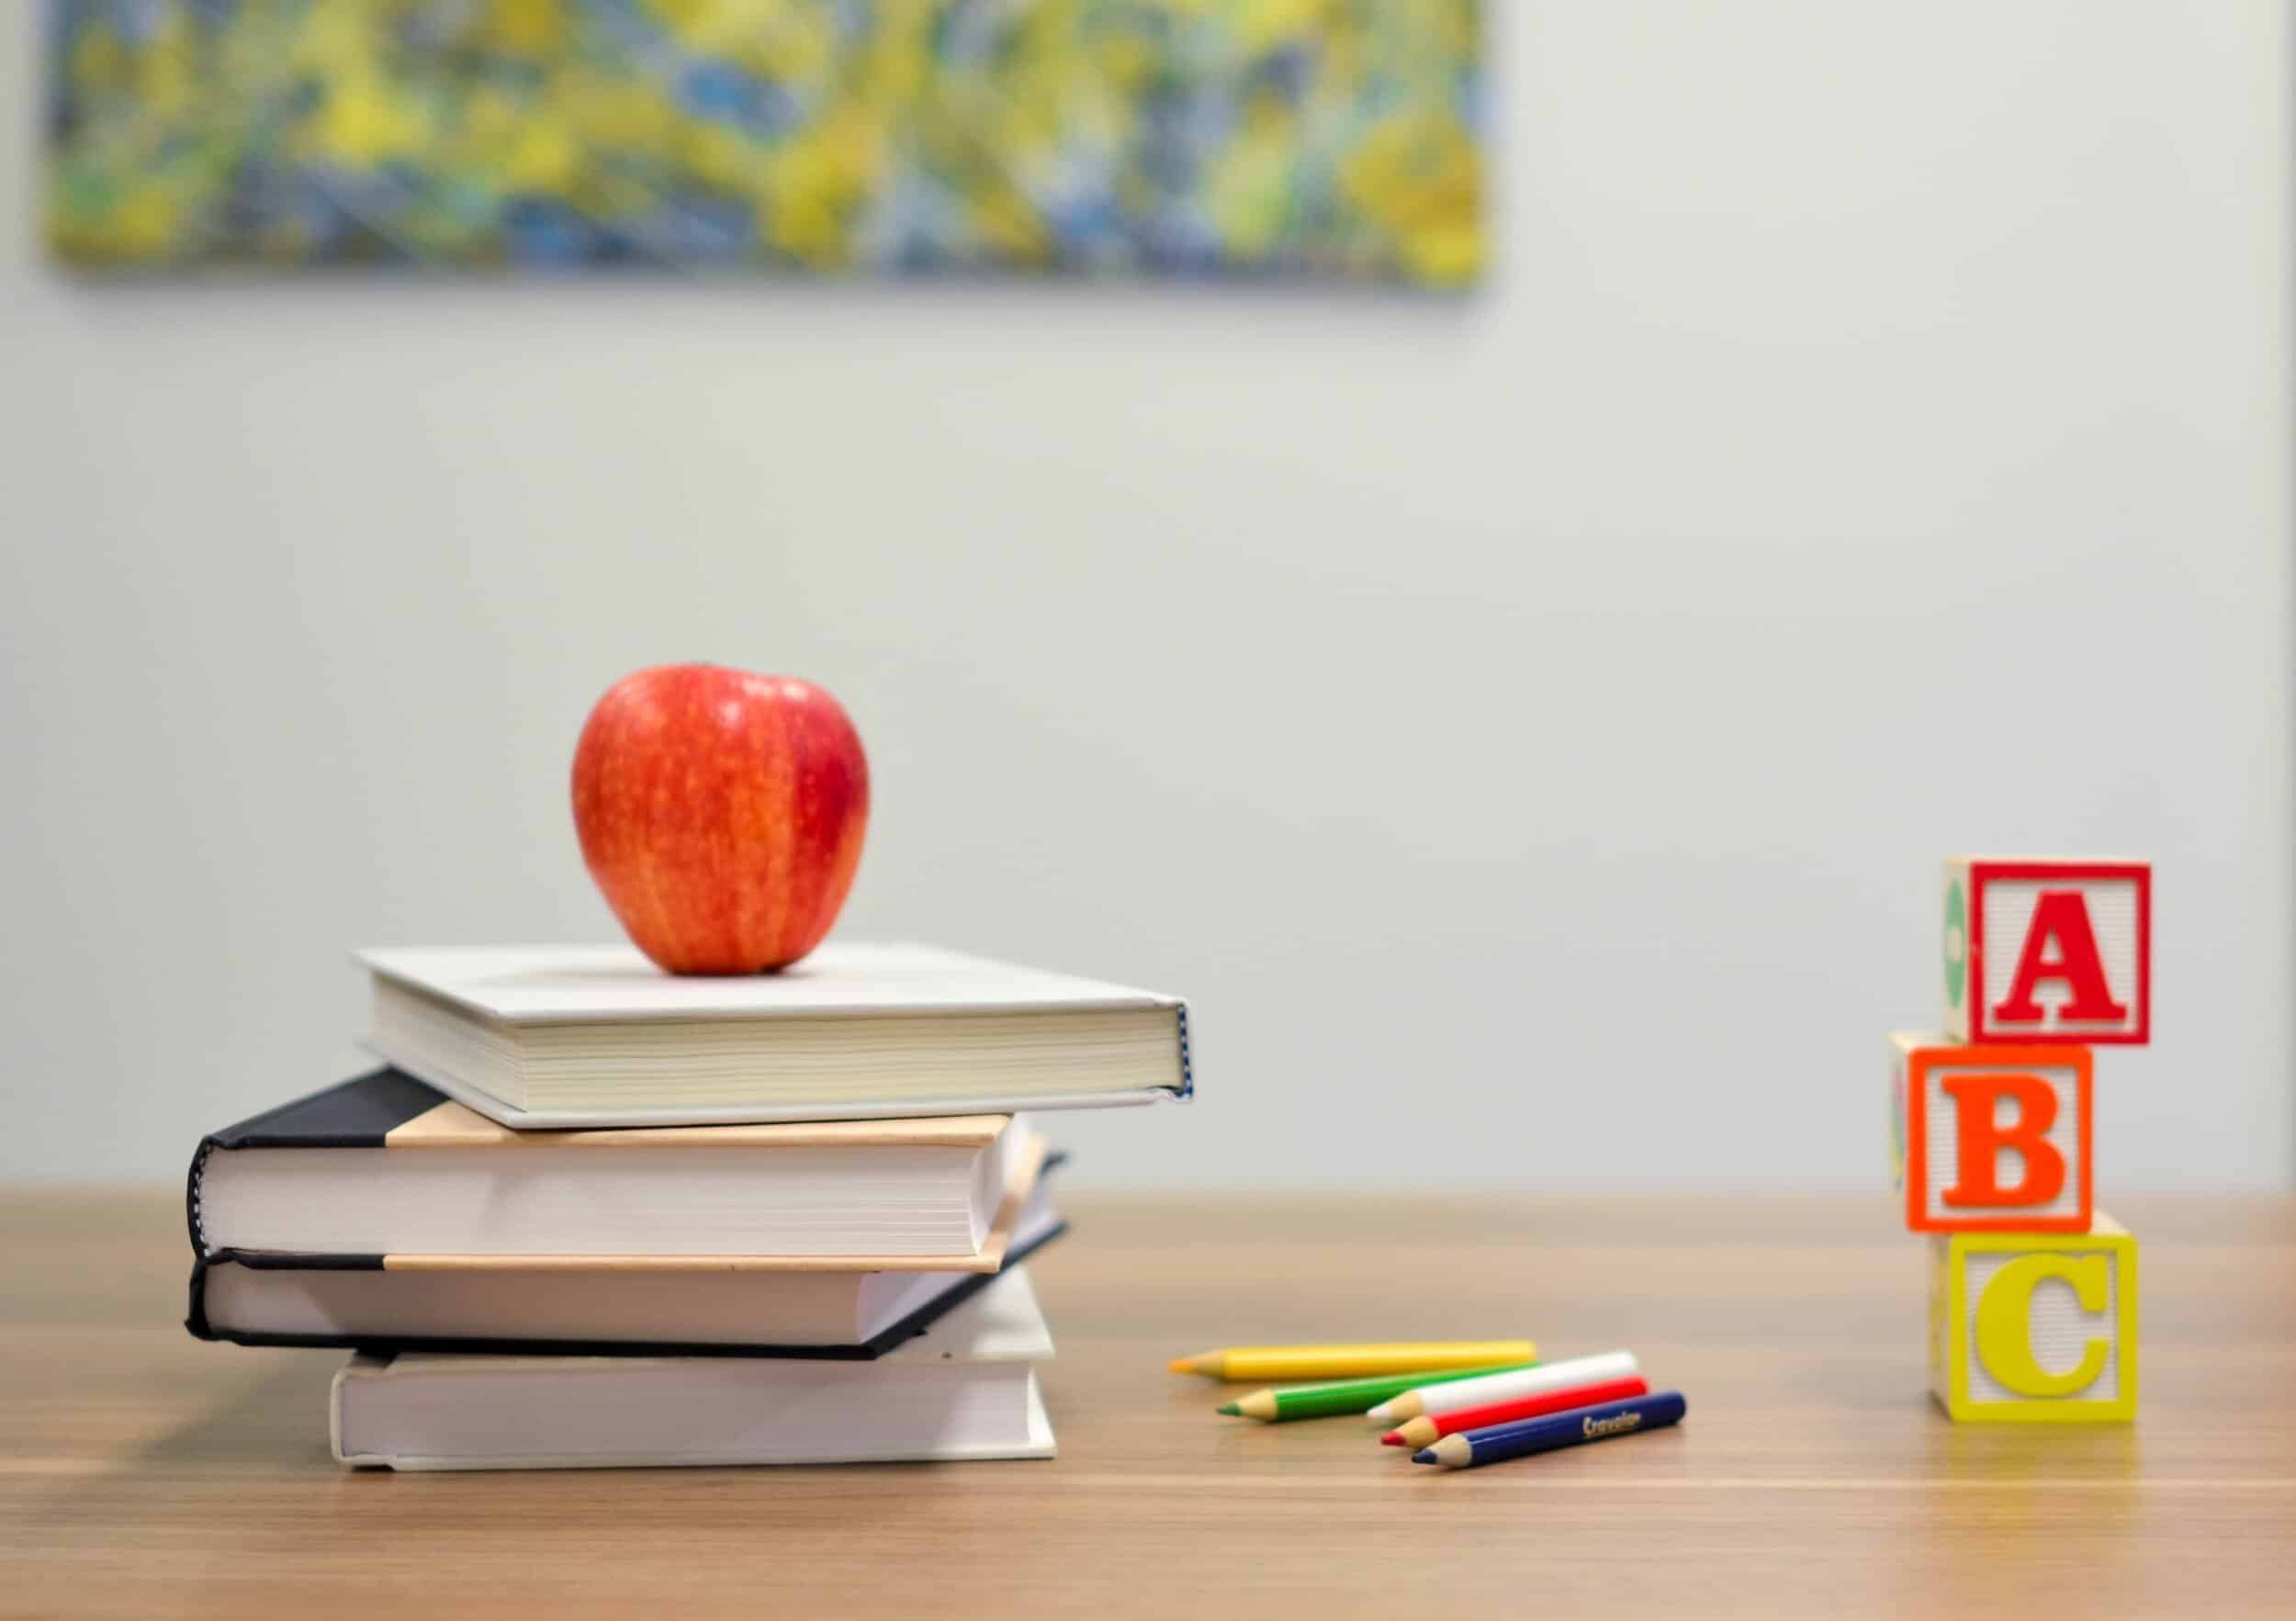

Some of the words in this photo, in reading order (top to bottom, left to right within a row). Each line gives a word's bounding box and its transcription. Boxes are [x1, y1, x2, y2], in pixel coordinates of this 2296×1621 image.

[1992, 889, 2128, 1024] A
[1941, 1072, 2066, 1208] B
[1975, 1252, 2110, 1398] C
